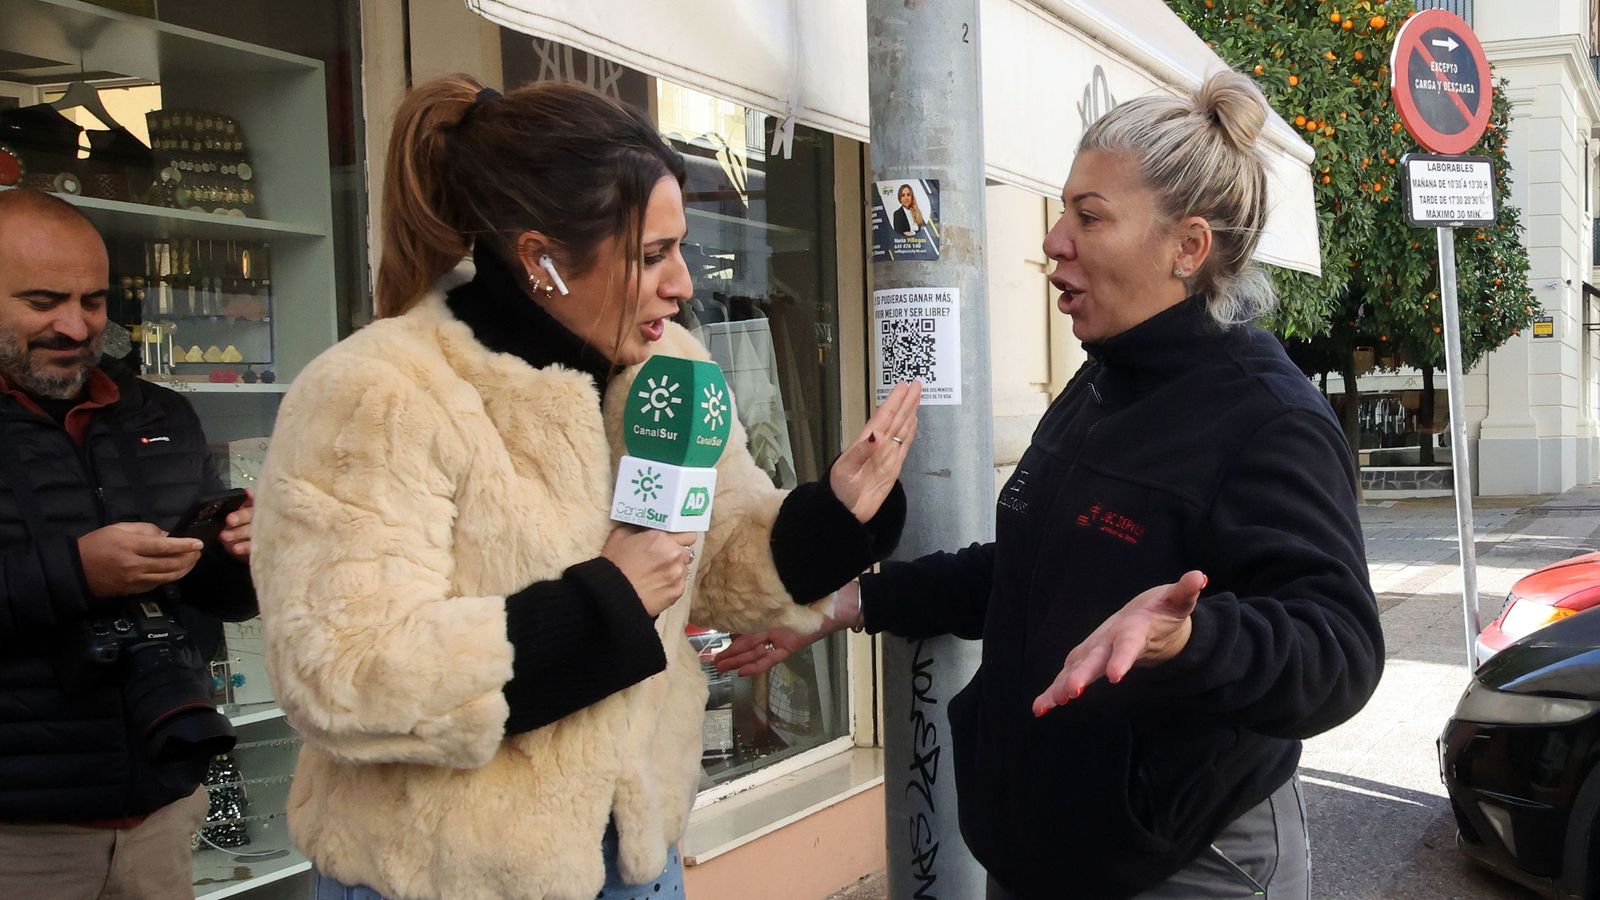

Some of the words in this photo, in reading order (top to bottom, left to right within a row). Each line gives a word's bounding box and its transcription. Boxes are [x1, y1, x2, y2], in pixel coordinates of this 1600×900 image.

[962, 22, 969, 44] 2
[1430, 61, 1458, 73] EXCEPTO
[1415, 78, 1437, 91] CARGA
[1437, 80, 1442, 94] Y
[1443, 80, 1475, 94] DESCARGA
[1427, 162, 1474, 173] LABORABLES
[1412, 177, 1437, 189] MAÑANA
[1439, 179, 1446, 189] DE
[1419, 195, 1438, 205] TARDE
[1439, 195, 1447, 205] DE
[1457, 210, 1466, 219] 30
[881, 294, 907, 304] PUDIERAS
[908, 293, 933, 304] GANAR
[935, 291, 954, 304] MÁS,
[885, 308, 903, 318] MEJOR
[903, 308, 909, 317] Y
[909, 307, 923, 317] SER
[925, 307, 950, 317] LIBRE?
[633, 424, 678, 441] CanalSur
[696, 435, 723, 447] CanalSur
[685, 492, 706, 511] AD
